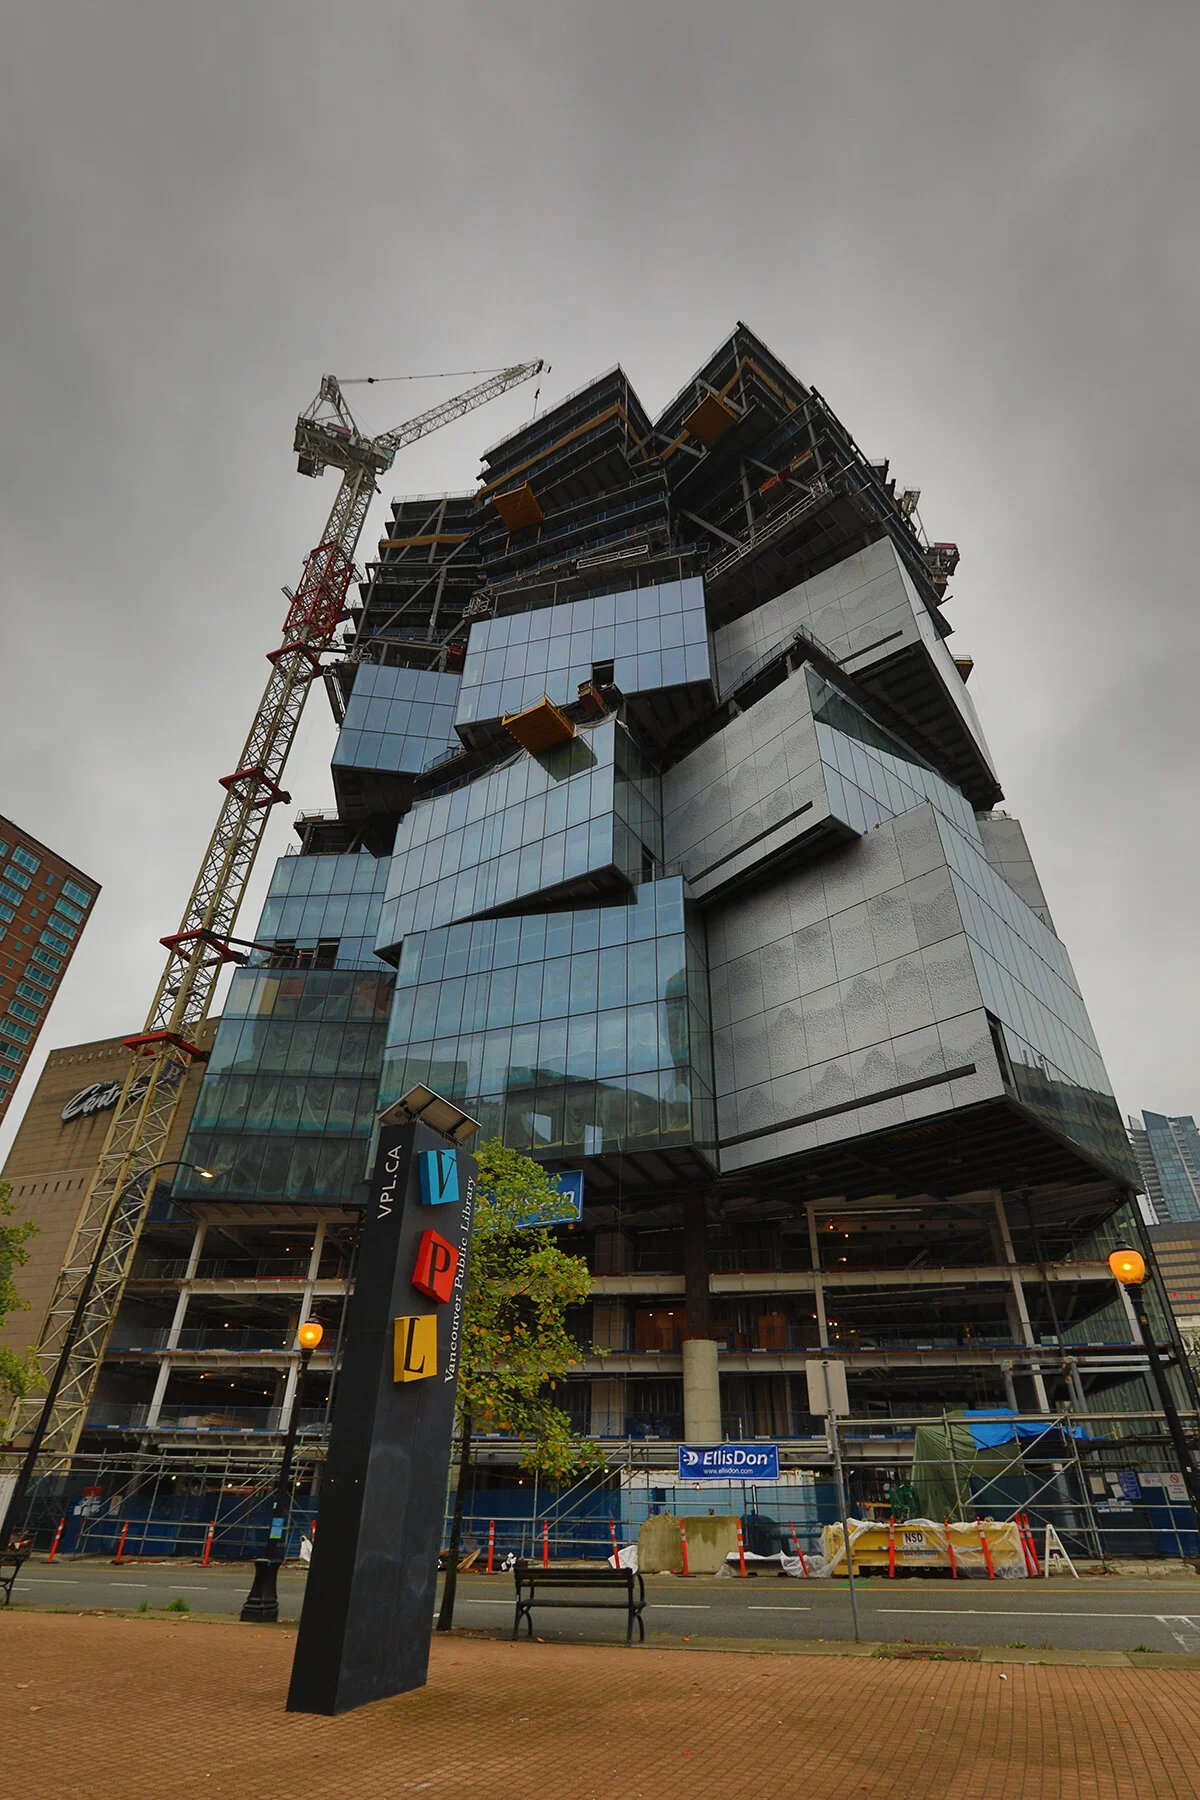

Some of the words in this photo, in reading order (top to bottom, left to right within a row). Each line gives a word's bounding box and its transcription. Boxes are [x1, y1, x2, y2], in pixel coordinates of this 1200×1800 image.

[377, 1145, 402, 1219] VPL.CA
[460, 1176, 476, 1232] Library
[454, 1237, 468, 1290] Public
[443, 1294, 462, 1383] Vancouver
[703, 1450, 768, 1465] EllisDon
[703, 1467, 754, 1475] www.ellisdon.com
[904, 1532, 923, 1543] NSD
